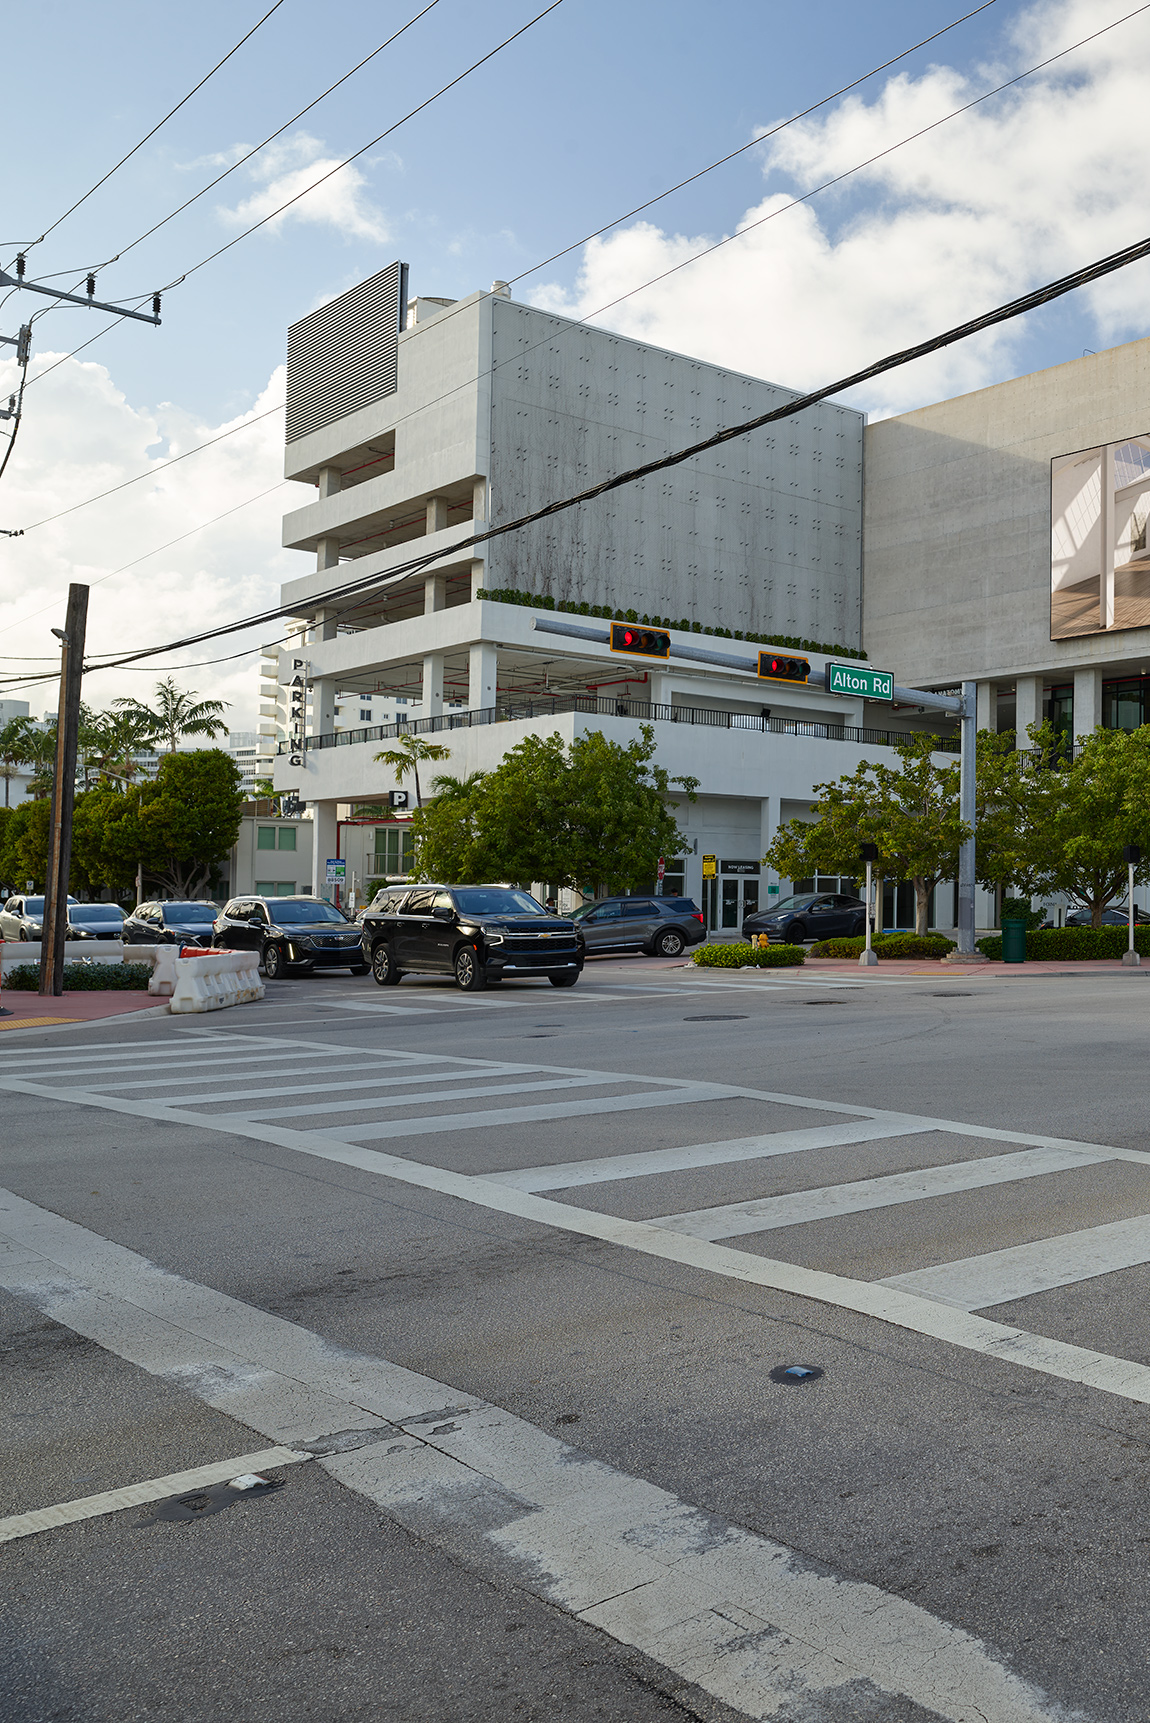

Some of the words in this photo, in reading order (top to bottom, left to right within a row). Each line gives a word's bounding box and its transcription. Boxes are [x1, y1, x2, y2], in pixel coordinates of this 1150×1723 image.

[833, 671, 867, 691] Alton
[873, 677, 890, 694] Rd
[290, 659, 304, 767] PARKING
[393, 792, 407, 806] P
